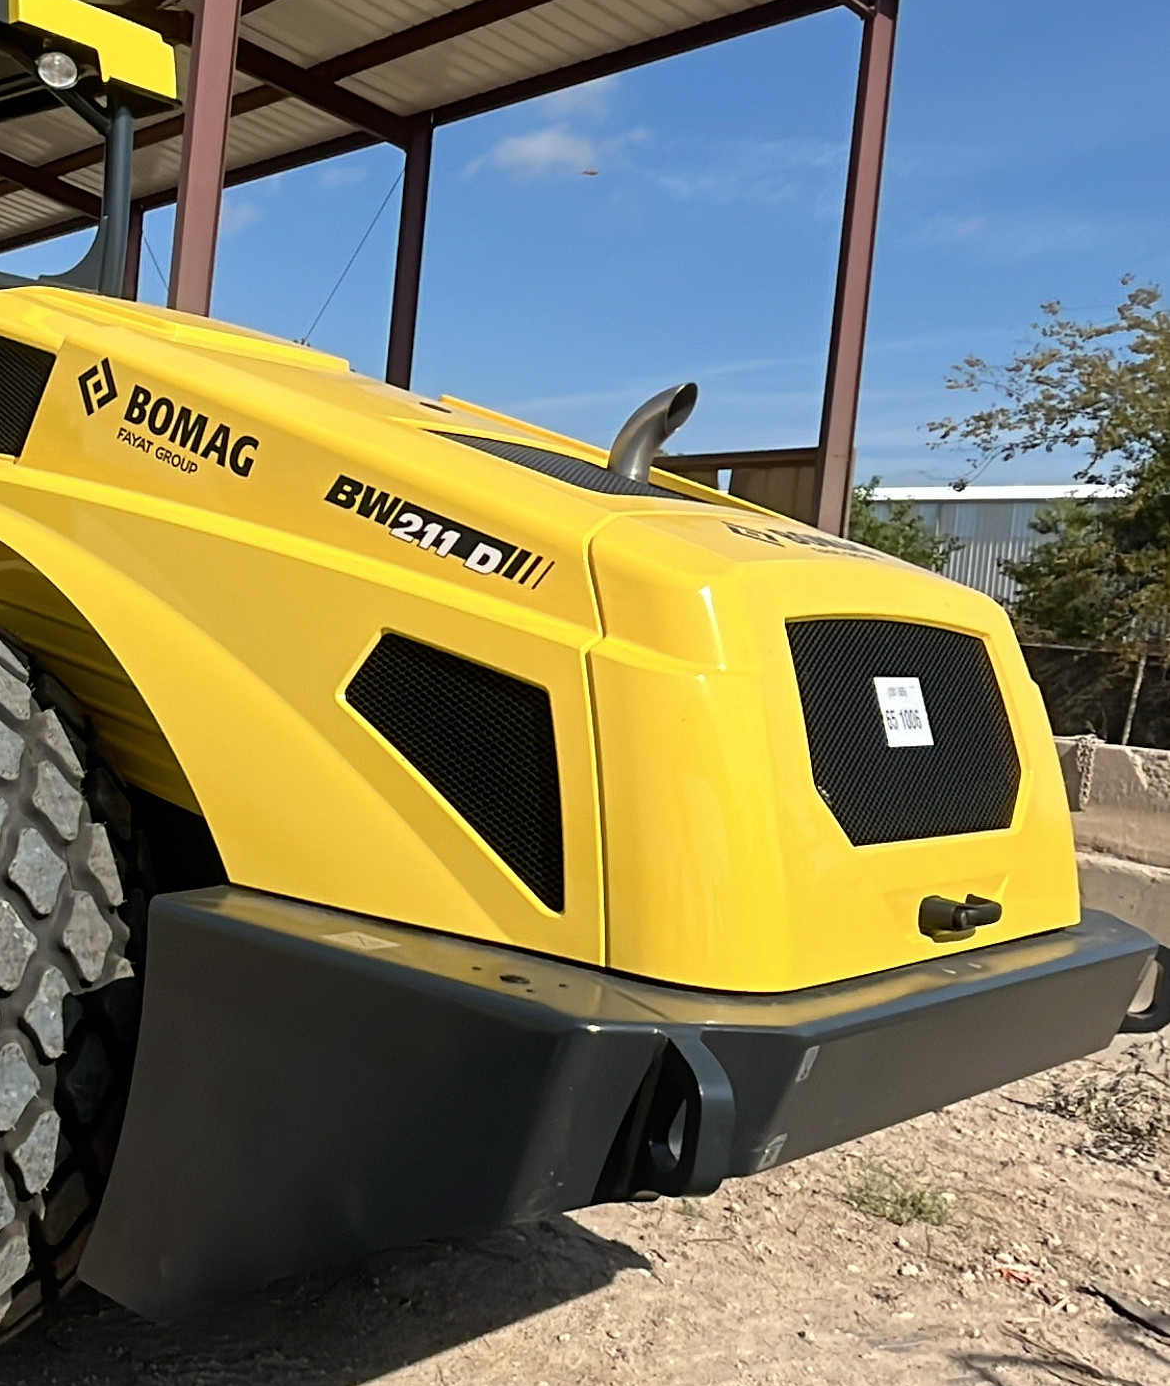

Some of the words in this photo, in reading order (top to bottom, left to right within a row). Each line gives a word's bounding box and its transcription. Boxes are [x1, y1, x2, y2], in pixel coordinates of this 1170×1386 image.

[116, 427, 154, 454] FAYAT
[155, 446, 199, 475] GROUP
[123, 384, 260, 478] BOMAG
[463, 542, 504, 575] D
